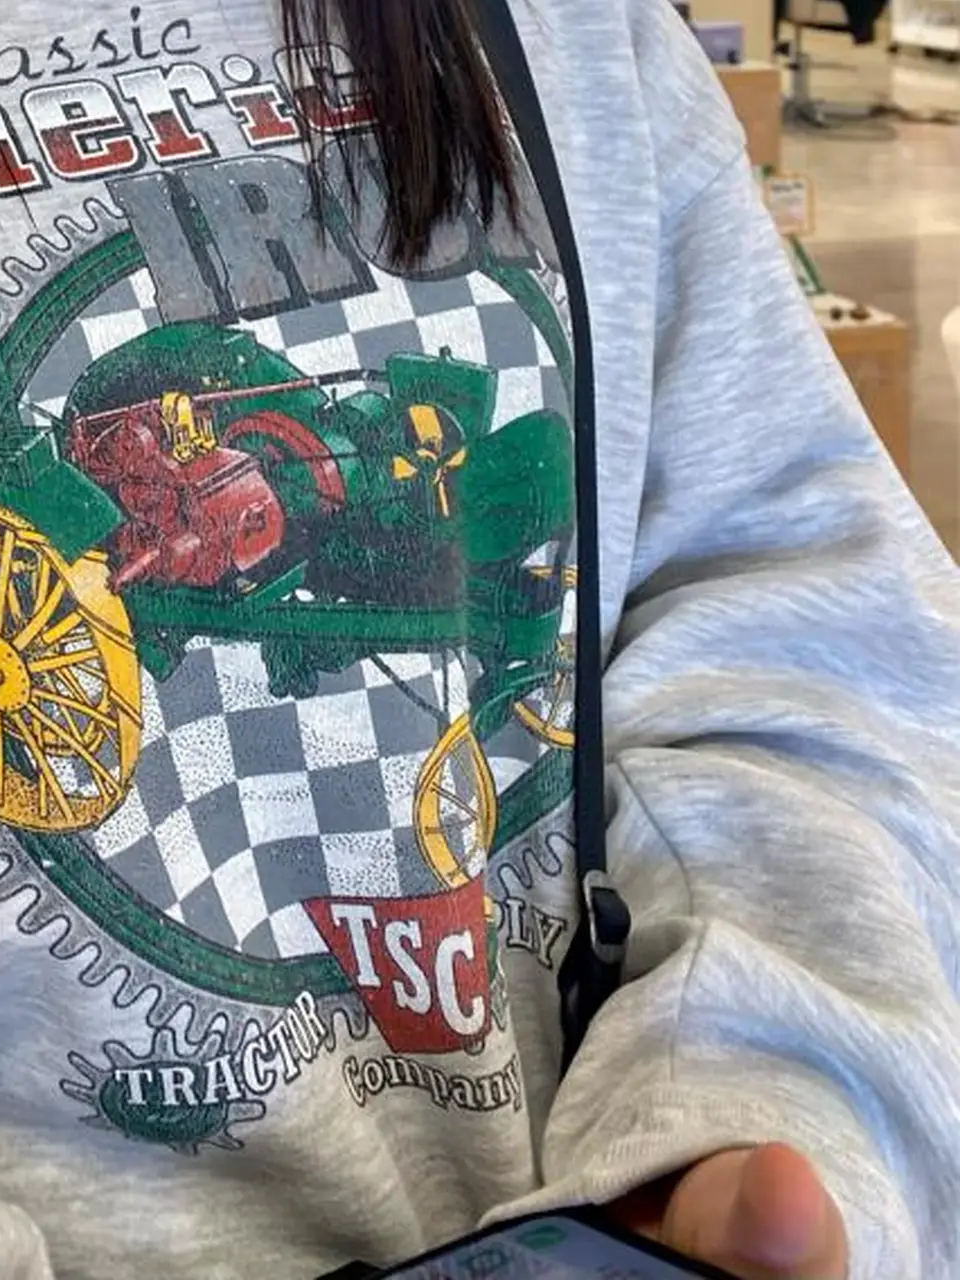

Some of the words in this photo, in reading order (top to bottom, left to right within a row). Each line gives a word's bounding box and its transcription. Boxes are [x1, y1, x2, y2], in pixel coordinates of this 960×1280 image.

[330, 903, 486, 1036] TSC
[113, 989, 328, 1106] TRACTOR
[343, 1054, 523, 1113] Company
